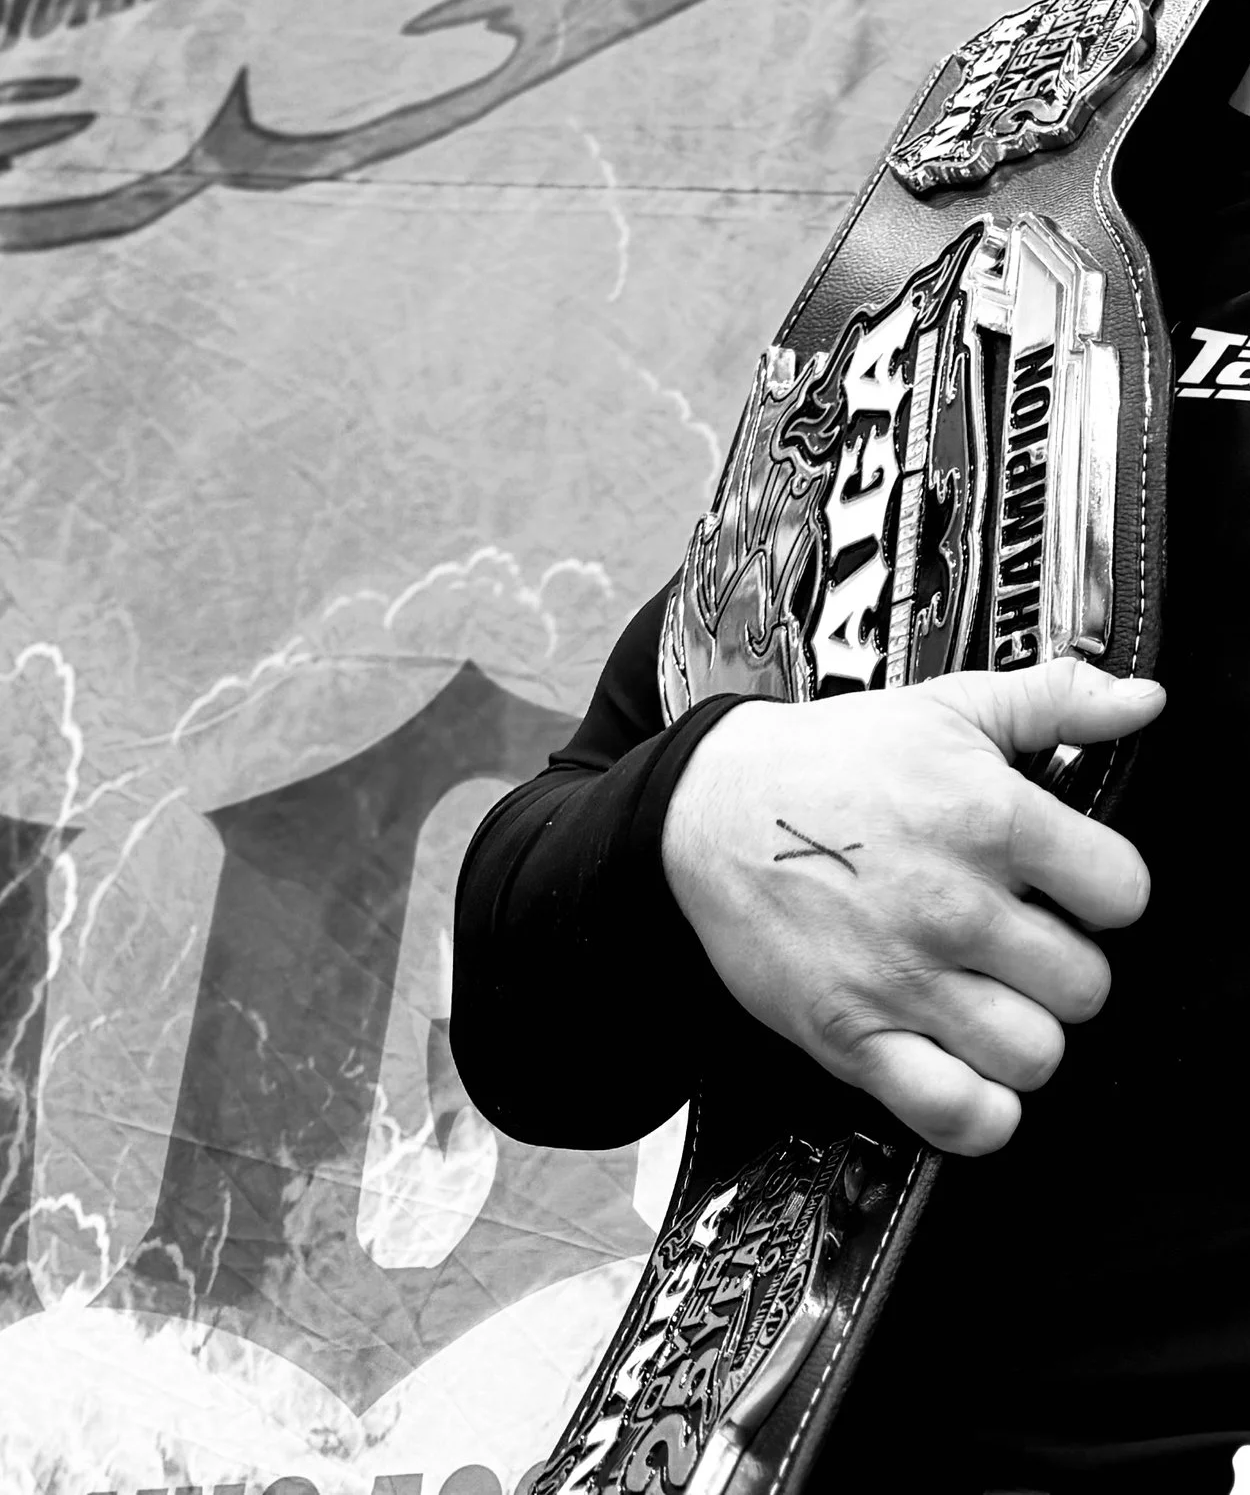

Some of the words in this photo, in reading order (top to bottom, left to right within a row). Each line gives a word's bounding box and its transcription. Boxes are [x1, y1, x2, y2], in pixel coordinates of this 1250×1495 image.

[994, 343, 1056, 671] CHAMPION
[635, 1251, 733, 1420] OVER
[735, 1268, 785, 1363] SUBMITTING
[779, 1241, 800, 1273] THE
[625, 1348, 719, 1493] 25
